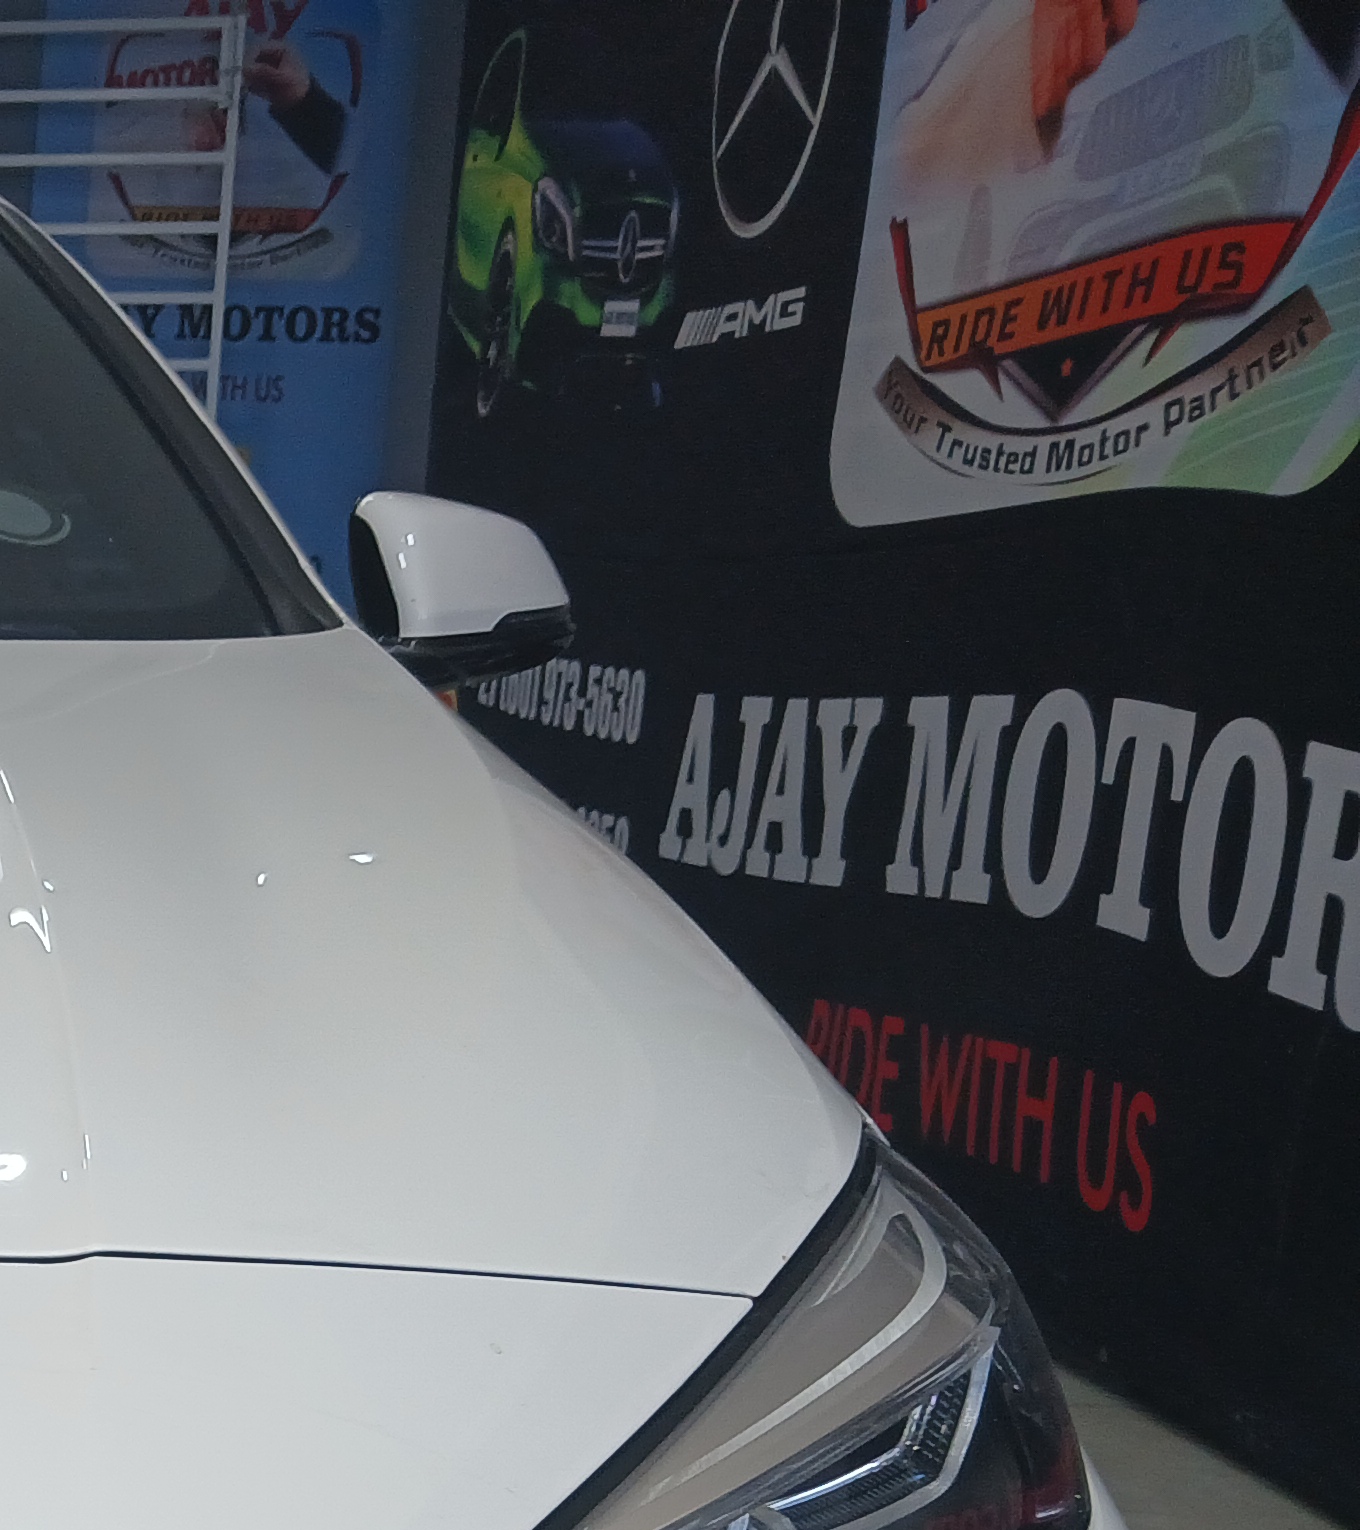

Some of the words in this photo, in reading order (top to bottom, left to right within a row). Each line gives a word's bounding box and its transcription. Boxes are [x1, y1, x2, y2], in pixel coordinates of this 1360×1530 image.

[175, 302, 380, 344] MOTORS
[710, 286, 807, 344] AMG
[923, 297, 1024, 362] RIDE
[1036, 258, 1161, 331] WITH
[1175, 241, 1248, 296] US
[883, 378, 926, 436] Your
[935, 420, 1036, 475] Trusted
[1045, 421, 1151, 474] Motor
[658, 693, 884, 888] AJAY
[919, 1022, 1059, 1184] WITH
[1077, 1069, 1157, 1233] US
